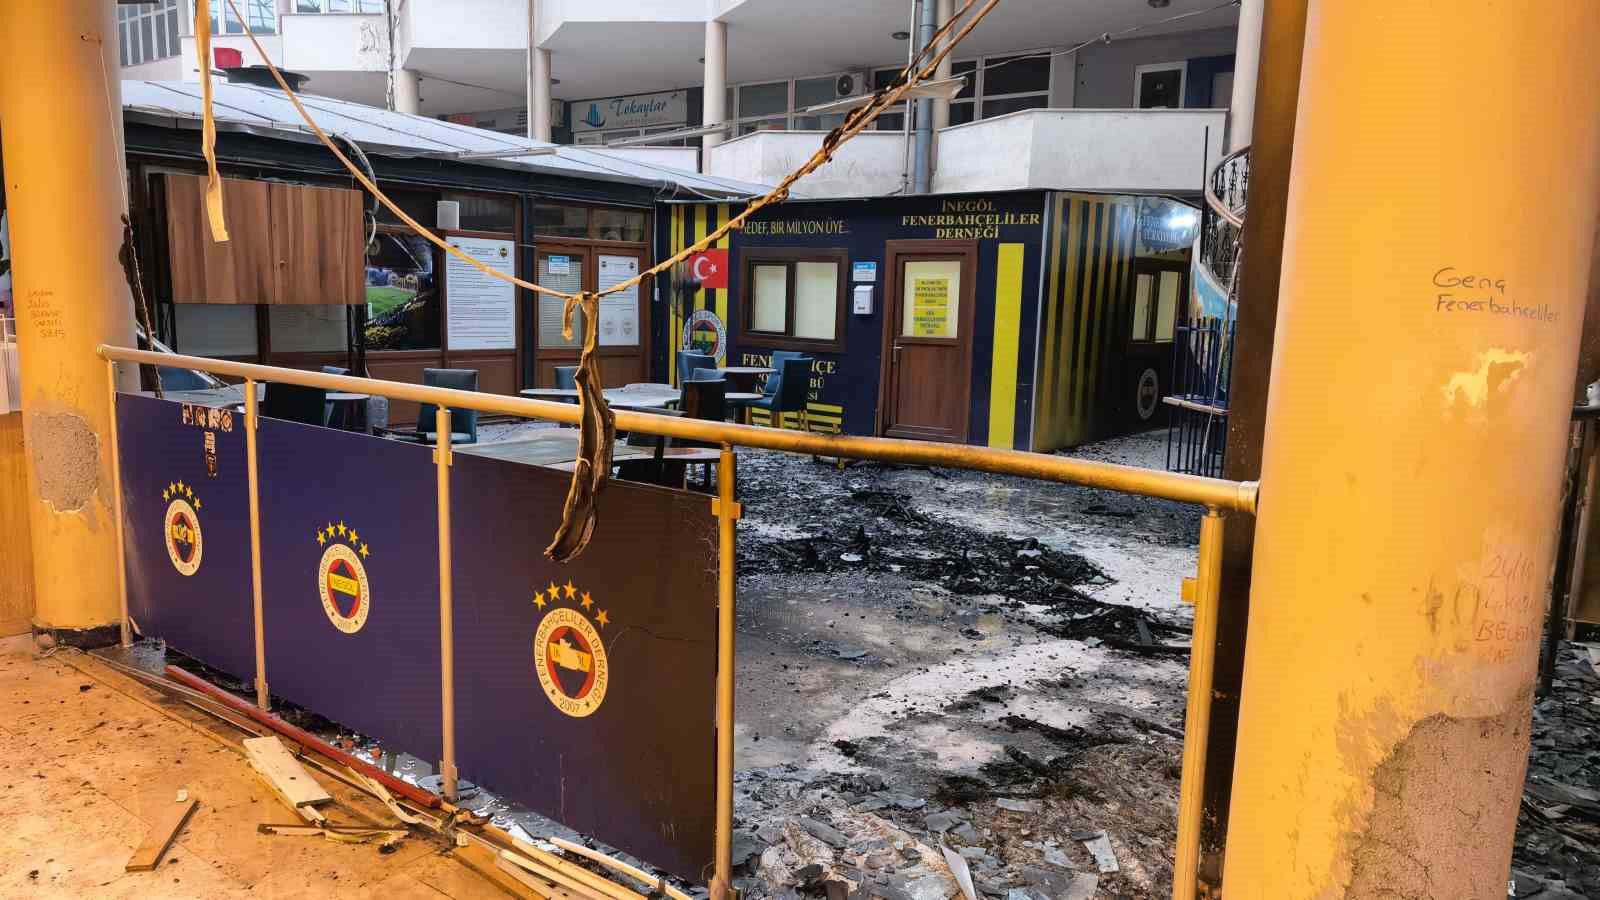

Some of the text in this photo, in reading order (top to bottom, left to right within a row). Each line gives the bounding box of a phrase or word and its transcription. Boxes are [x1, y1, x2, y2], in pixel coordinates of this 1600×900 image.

[942, 198, 996, 213] İNEGÖL
[771, 218, 785, 234] BİR
[786, 218, 823, 234] MİLYON
[901, 211, 1040, 227] FENERBAHÇELİLER
[935, 224, 999, 239] DERNEĞİ
[536, 609, 594, 686] FENERBAHÇELİLER
[559, 698, 581, 713] 2007
